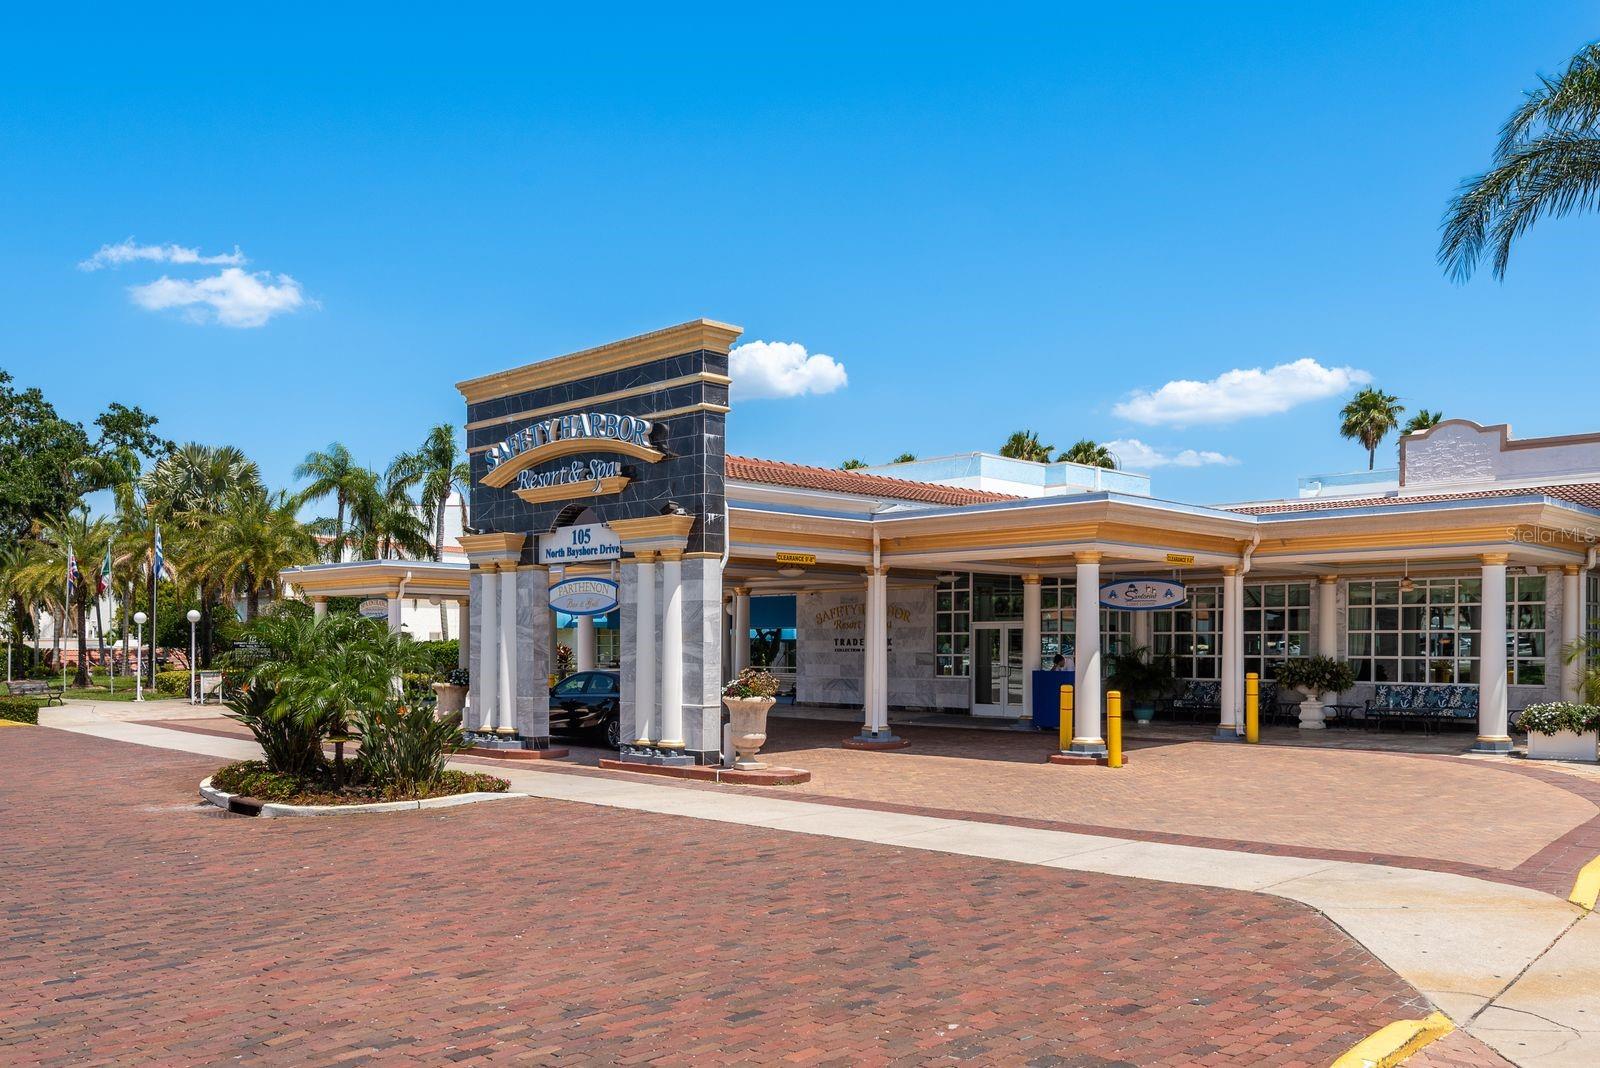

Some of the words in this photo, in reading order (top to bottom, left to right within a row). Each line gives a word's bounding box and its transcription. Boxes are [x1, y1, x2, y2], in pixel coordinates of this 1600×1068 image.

[484, 419, 558, 474] SAFETY
[559, 412, 650, 447] HARBOR
[517, 466, 567, 491] Resort
[568, 461, 584, 483] &
[586, 459, 617, 492] Spa
[572, 528, 591, 545] 105
[545, 548, 565, 559] North
[567, 545, 598, 559] Bayshore
[599, 544, 620, 555] Drive
[558, 581, 609, 596] PARTHENON
[815, 604, 858, 625] SAFETY
[833, 619, 862, 630] Resort
[834, 638, 893, 646] TRADEK
